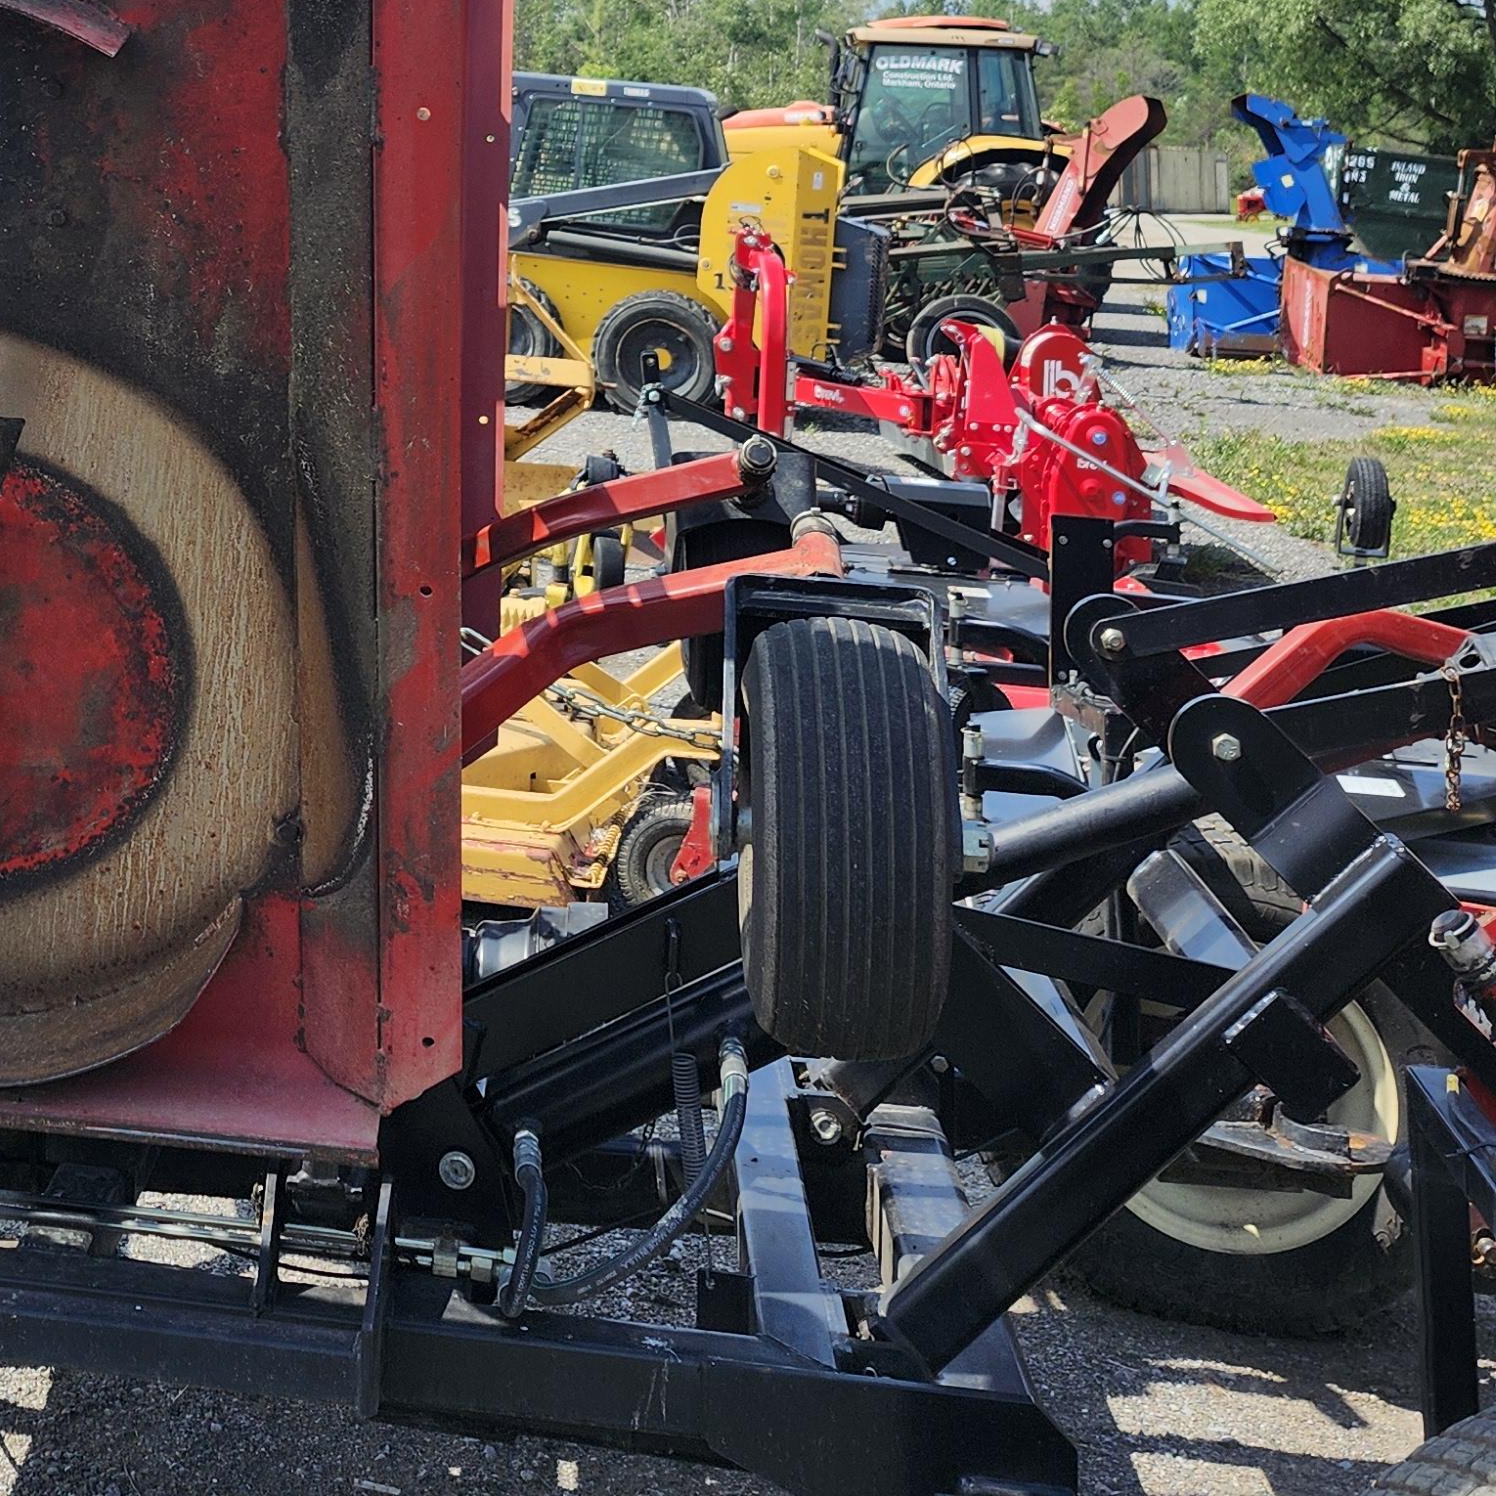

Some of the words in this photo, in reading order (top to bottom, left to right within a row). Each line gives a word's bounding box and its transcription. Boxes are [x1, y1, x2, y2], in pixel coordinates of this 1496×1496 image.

[875, 55, 964, 75] OLDMARK
[882, 71, 936, 81] Construction
[924, 80, 956, 90] Ontario
[1390, 161, 1426, 175] INLAND
[1388, 190, 1420, 204] METAL
